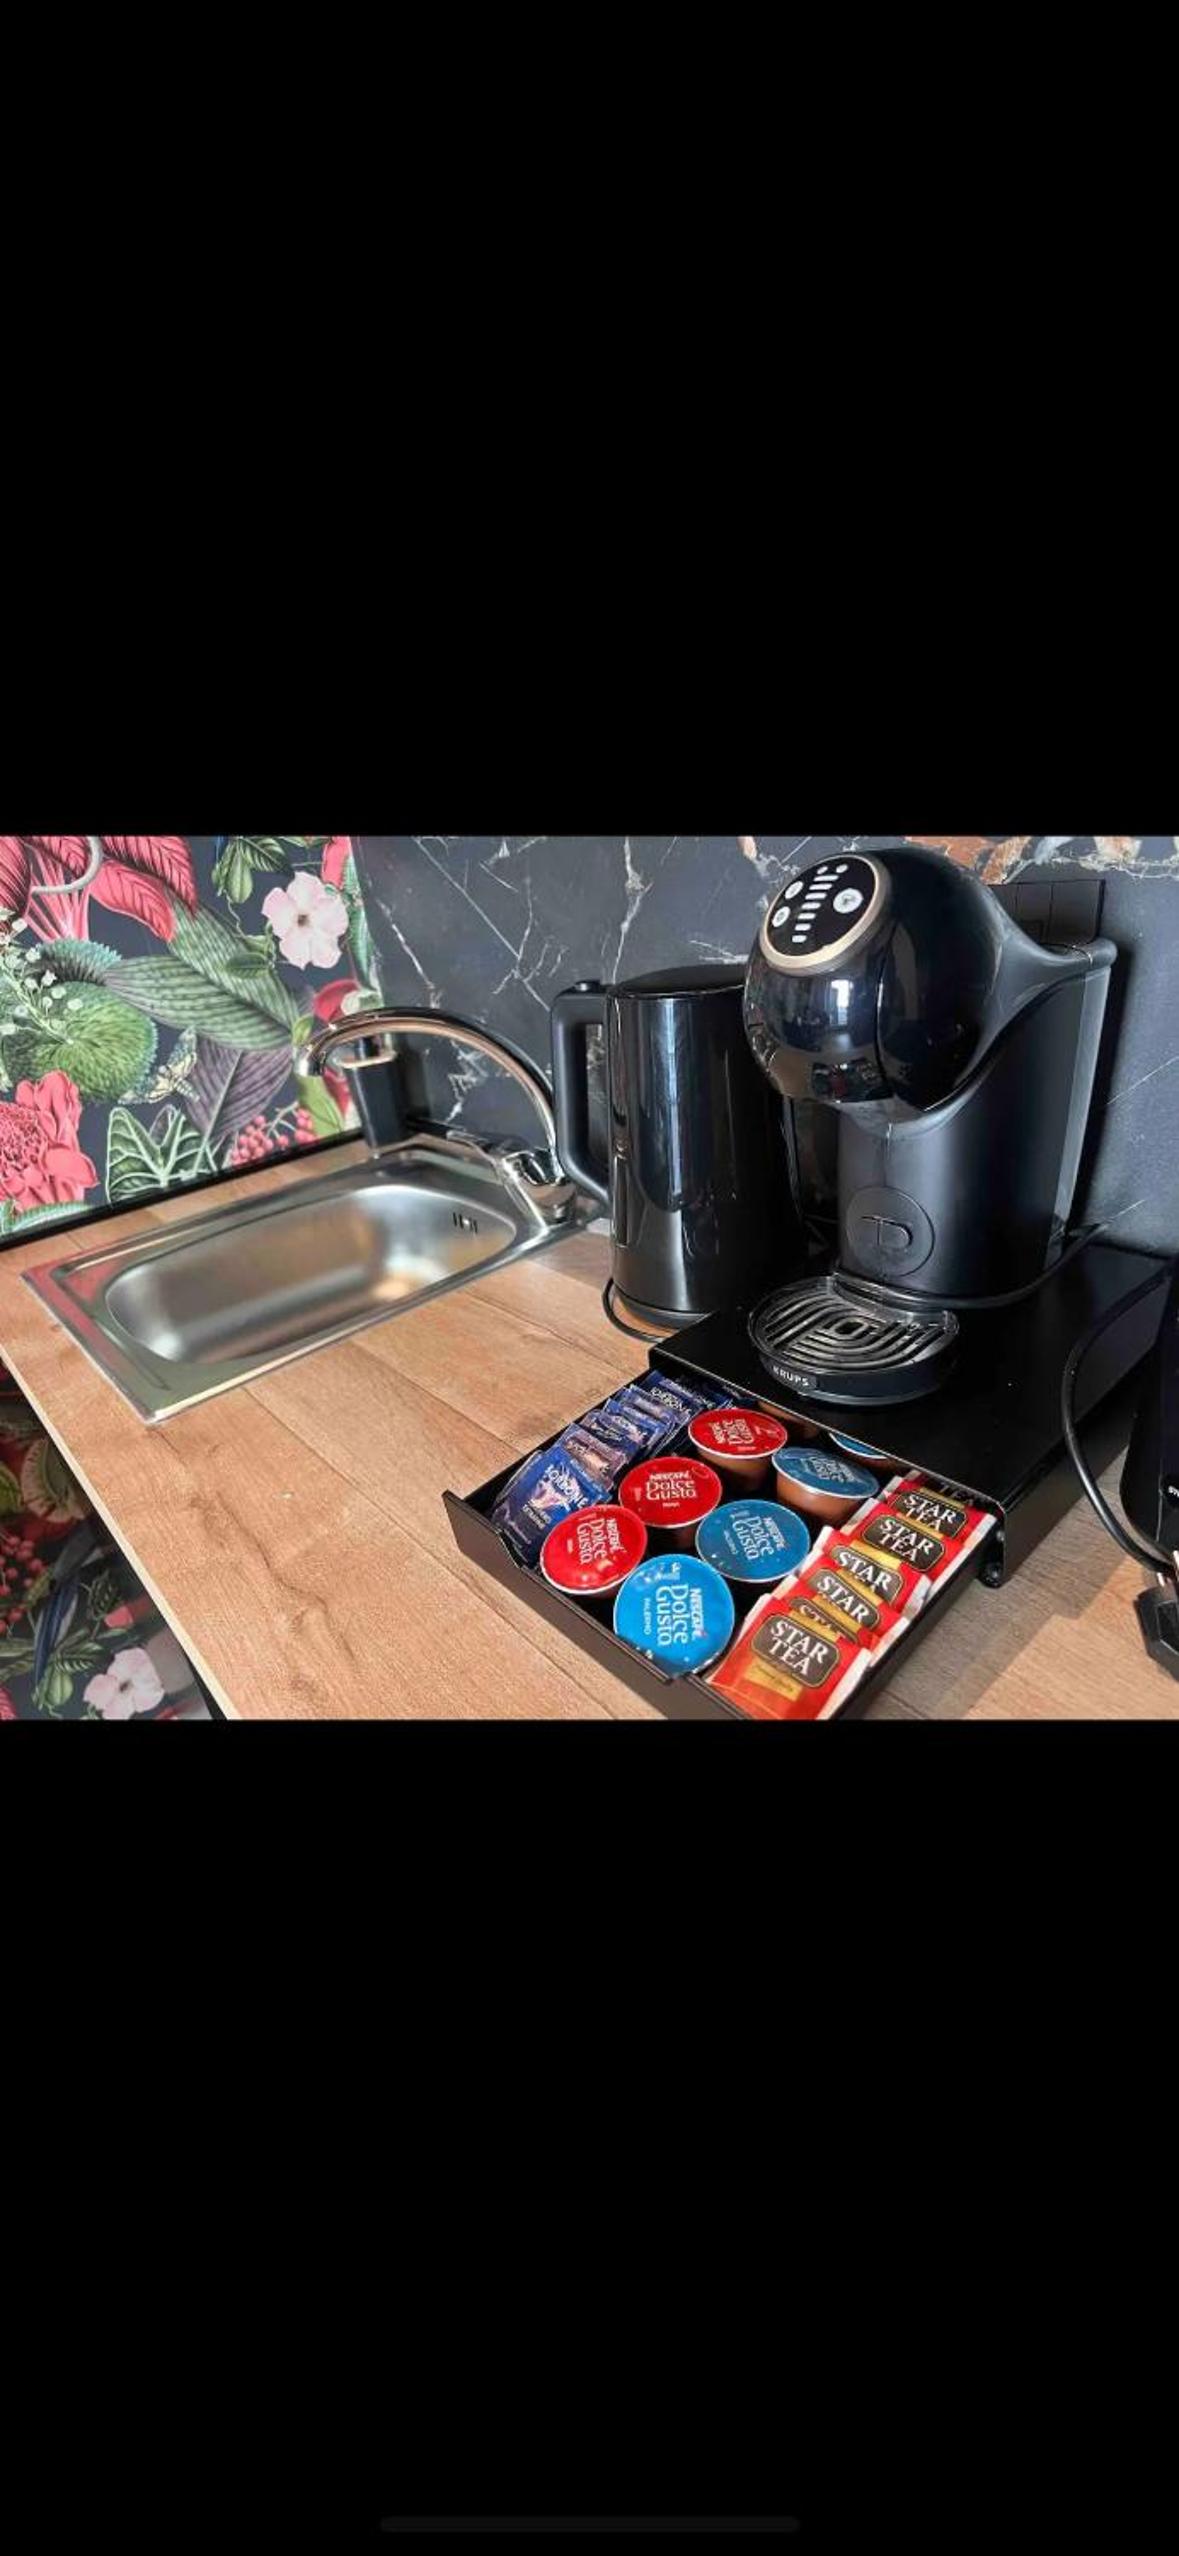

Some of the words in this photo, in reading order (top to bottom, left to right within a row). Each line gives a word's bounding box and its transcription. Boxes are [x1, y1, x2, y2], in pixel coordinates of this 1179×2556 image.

[773, 1365, 809, 1386] KRUPS
[645, 1488, 698, 1501] Gusto
[646, 1480, 695, 1493] Dolce
[904, 1494, 957, 1524] STAR
[905, 1506, 942, 1531] TEA
[577, 1523, 593, 1565] Gusto
[590, 1518, 608, 1559] Dolce
[732, 1520, 760, 1561] Gusto
[746, 1516, 775, 1557] Dolce
[880, 1518, 934, 1555] STAR
[880, 1531, 918, 1562] TEA
[837, 1552, 892, 1591] STAR
[656, 1586, 673, 1647] Gusto
[671, 1583, 691, 1645] Dolce
[817, 1576, 870, 1623] STAR
[768, 1636, 810, 1676] TEA
[771, 1620, 829, 1664] STAR
